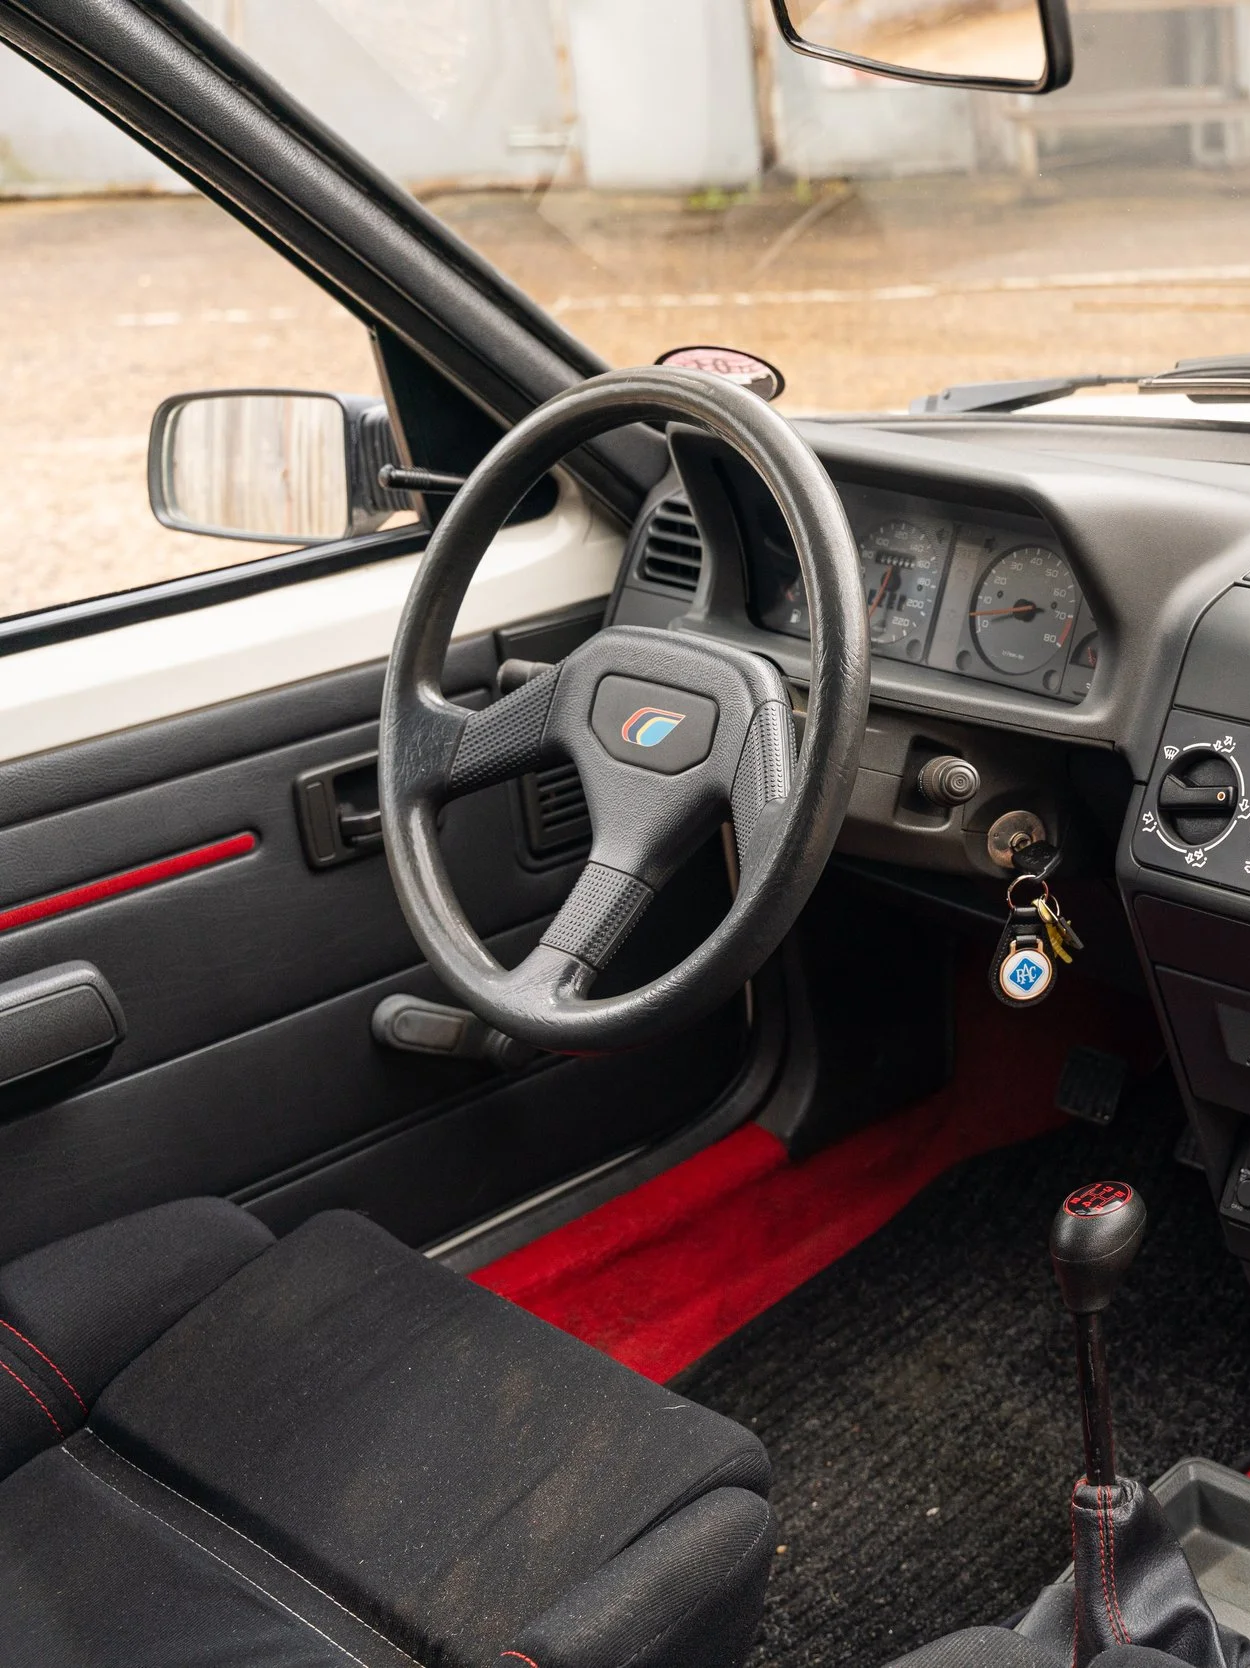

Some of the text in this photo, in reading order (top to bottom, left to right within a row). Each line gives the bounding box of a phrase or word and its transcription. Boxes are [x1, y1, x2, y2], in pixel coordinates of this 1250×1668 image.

[1010, 562, 1024, 571] 30
[1029, 557, 1044, 566] 40
[1044, 568, 1059, 578] 50
[994, 576, 1007, 586] 20
[1053, 589, 1066, 598] 60
[906, 599, 924, 609] 200
[983, 595, 993, 605] 10
[1054, 610, 1067, 620] 70
[891, 615, 910, 627] 220
[981, 619, 989, 628] 0
[1043, 633, 1057, 643] 80
[1016, 963, 1037, 985] RAC
